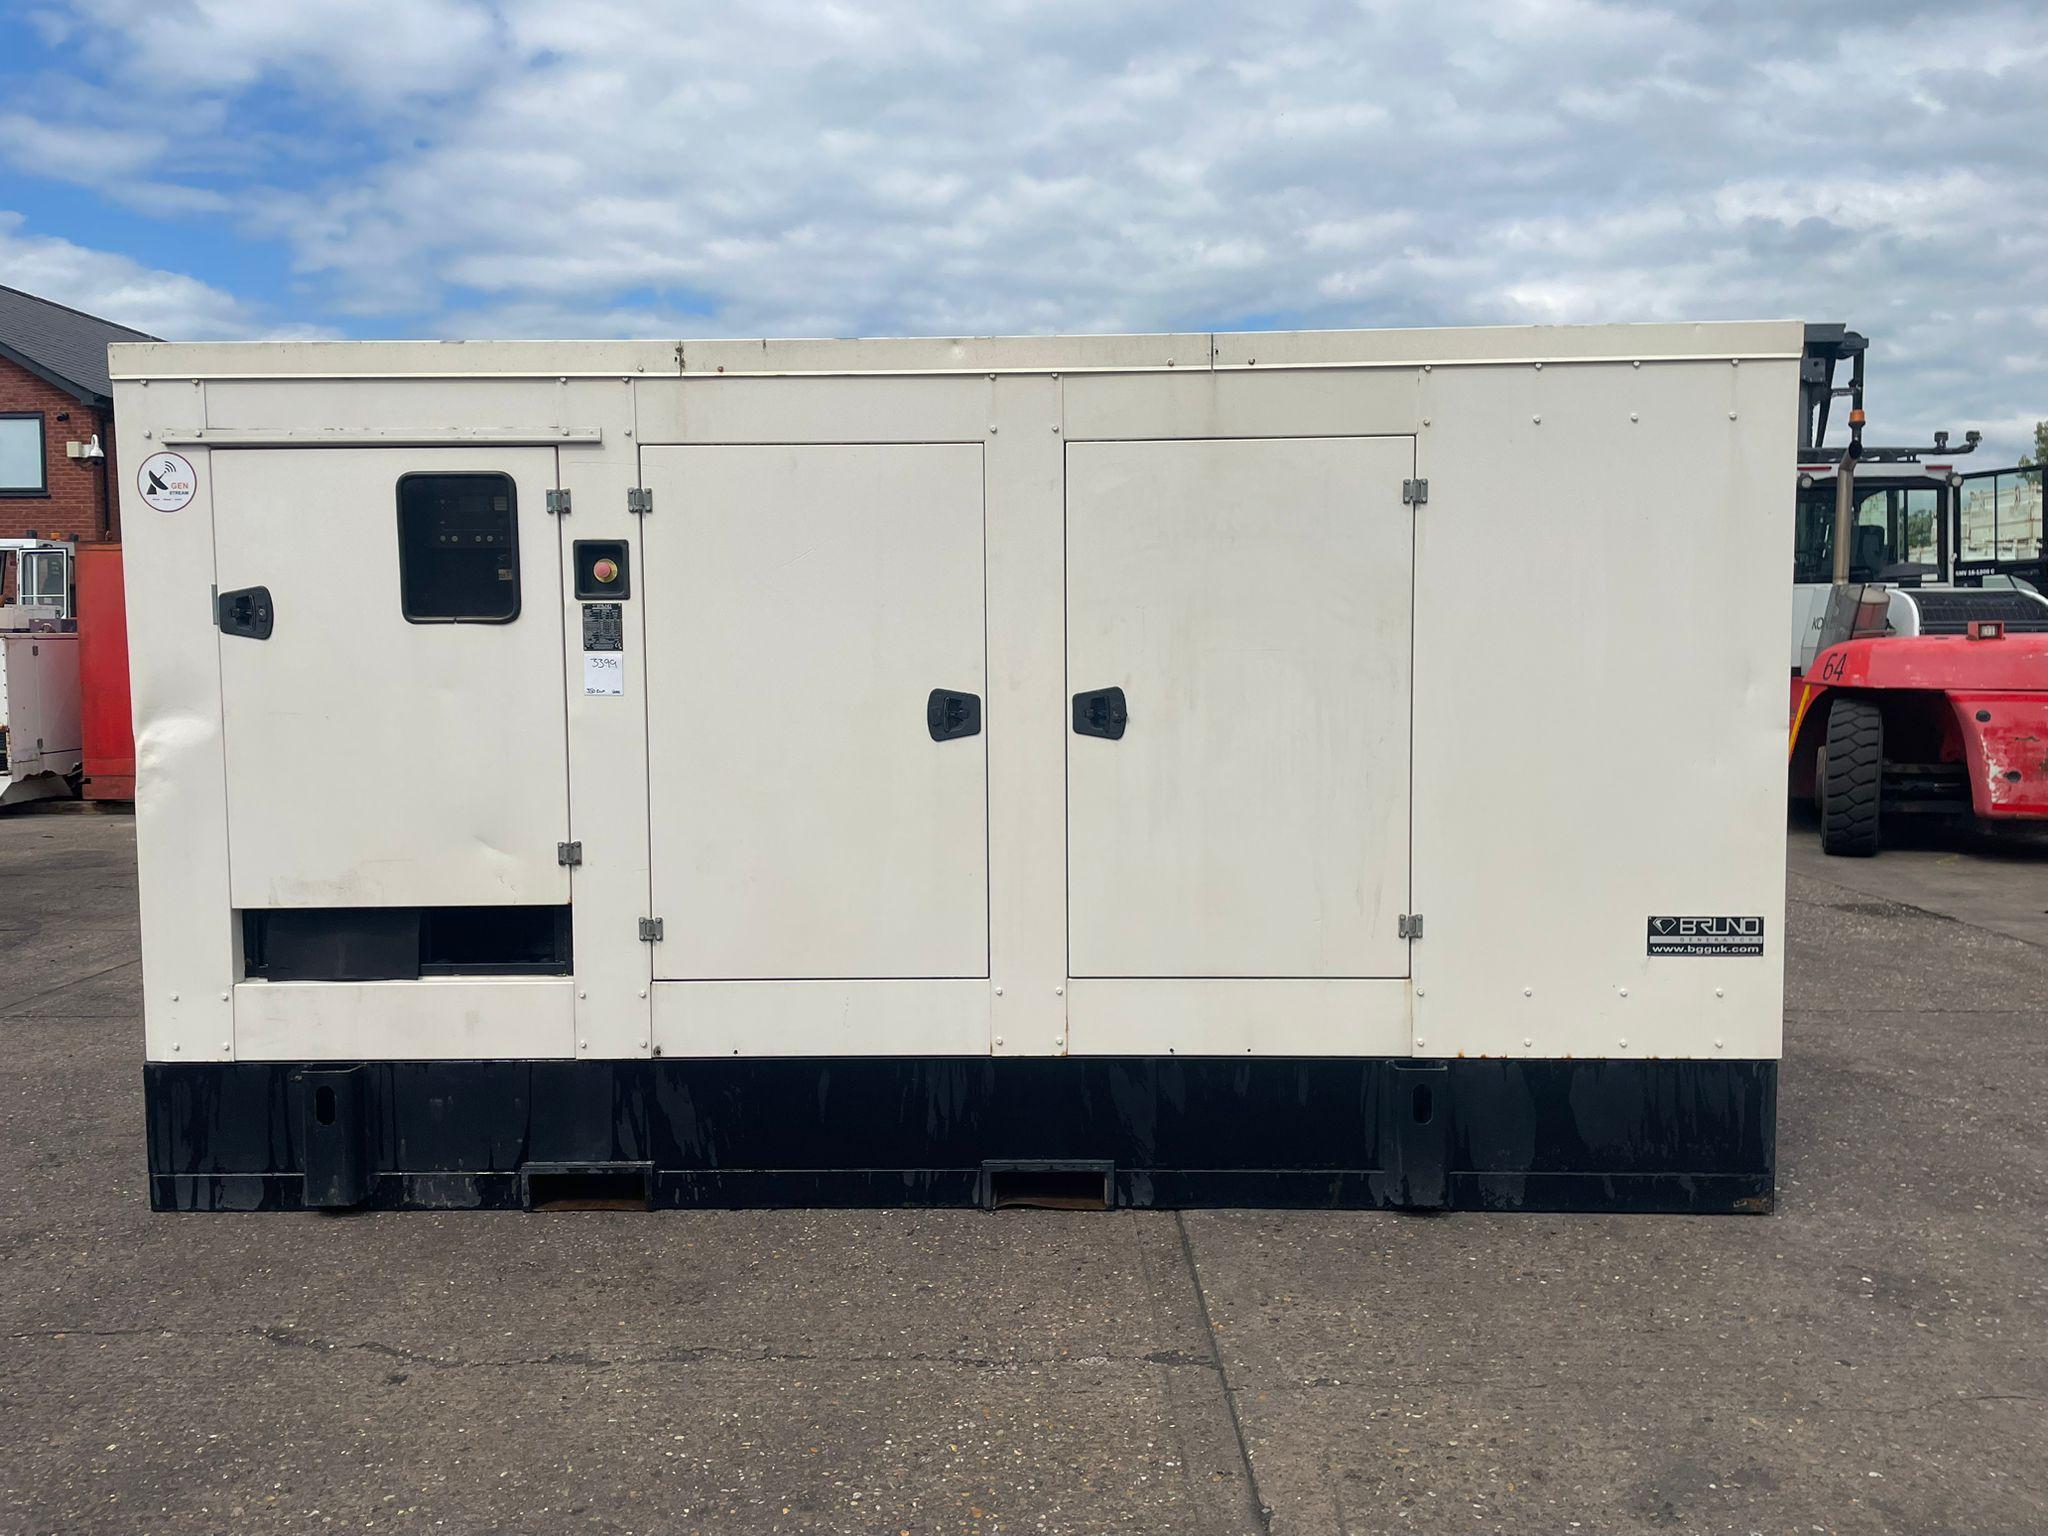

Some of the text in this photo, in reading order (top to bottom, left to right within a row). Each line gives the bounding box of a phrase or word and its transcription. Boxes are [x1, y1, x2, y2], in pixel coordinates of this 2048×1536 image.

[171, 482, 189, 490] GEN
[1822, 653, 1848, 682] 64
[1679, 918, 1760, 935] BRUNO
[1652, 945, 1760, 954] www.bgguk.com
